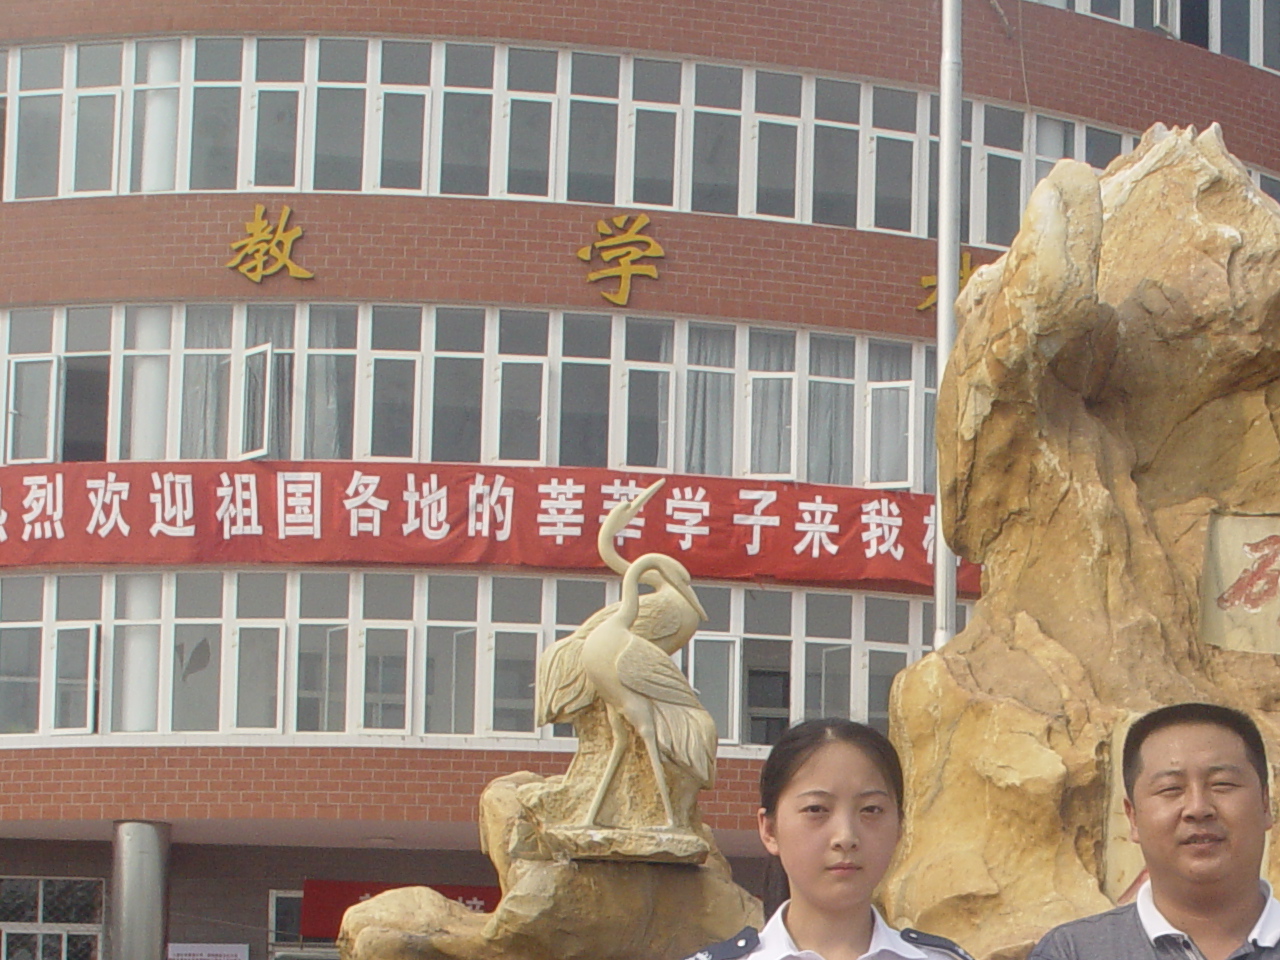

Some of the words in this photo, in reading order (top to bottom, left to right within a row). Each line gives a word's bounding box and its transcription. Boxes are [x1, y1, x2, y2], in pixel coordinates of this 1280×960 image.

[224, 203, 315, 284] 教
[576, 212, 666, 306] 学
[0, 470, 961, 565] 烈欢迎祖国各地的莘莘学子来我
